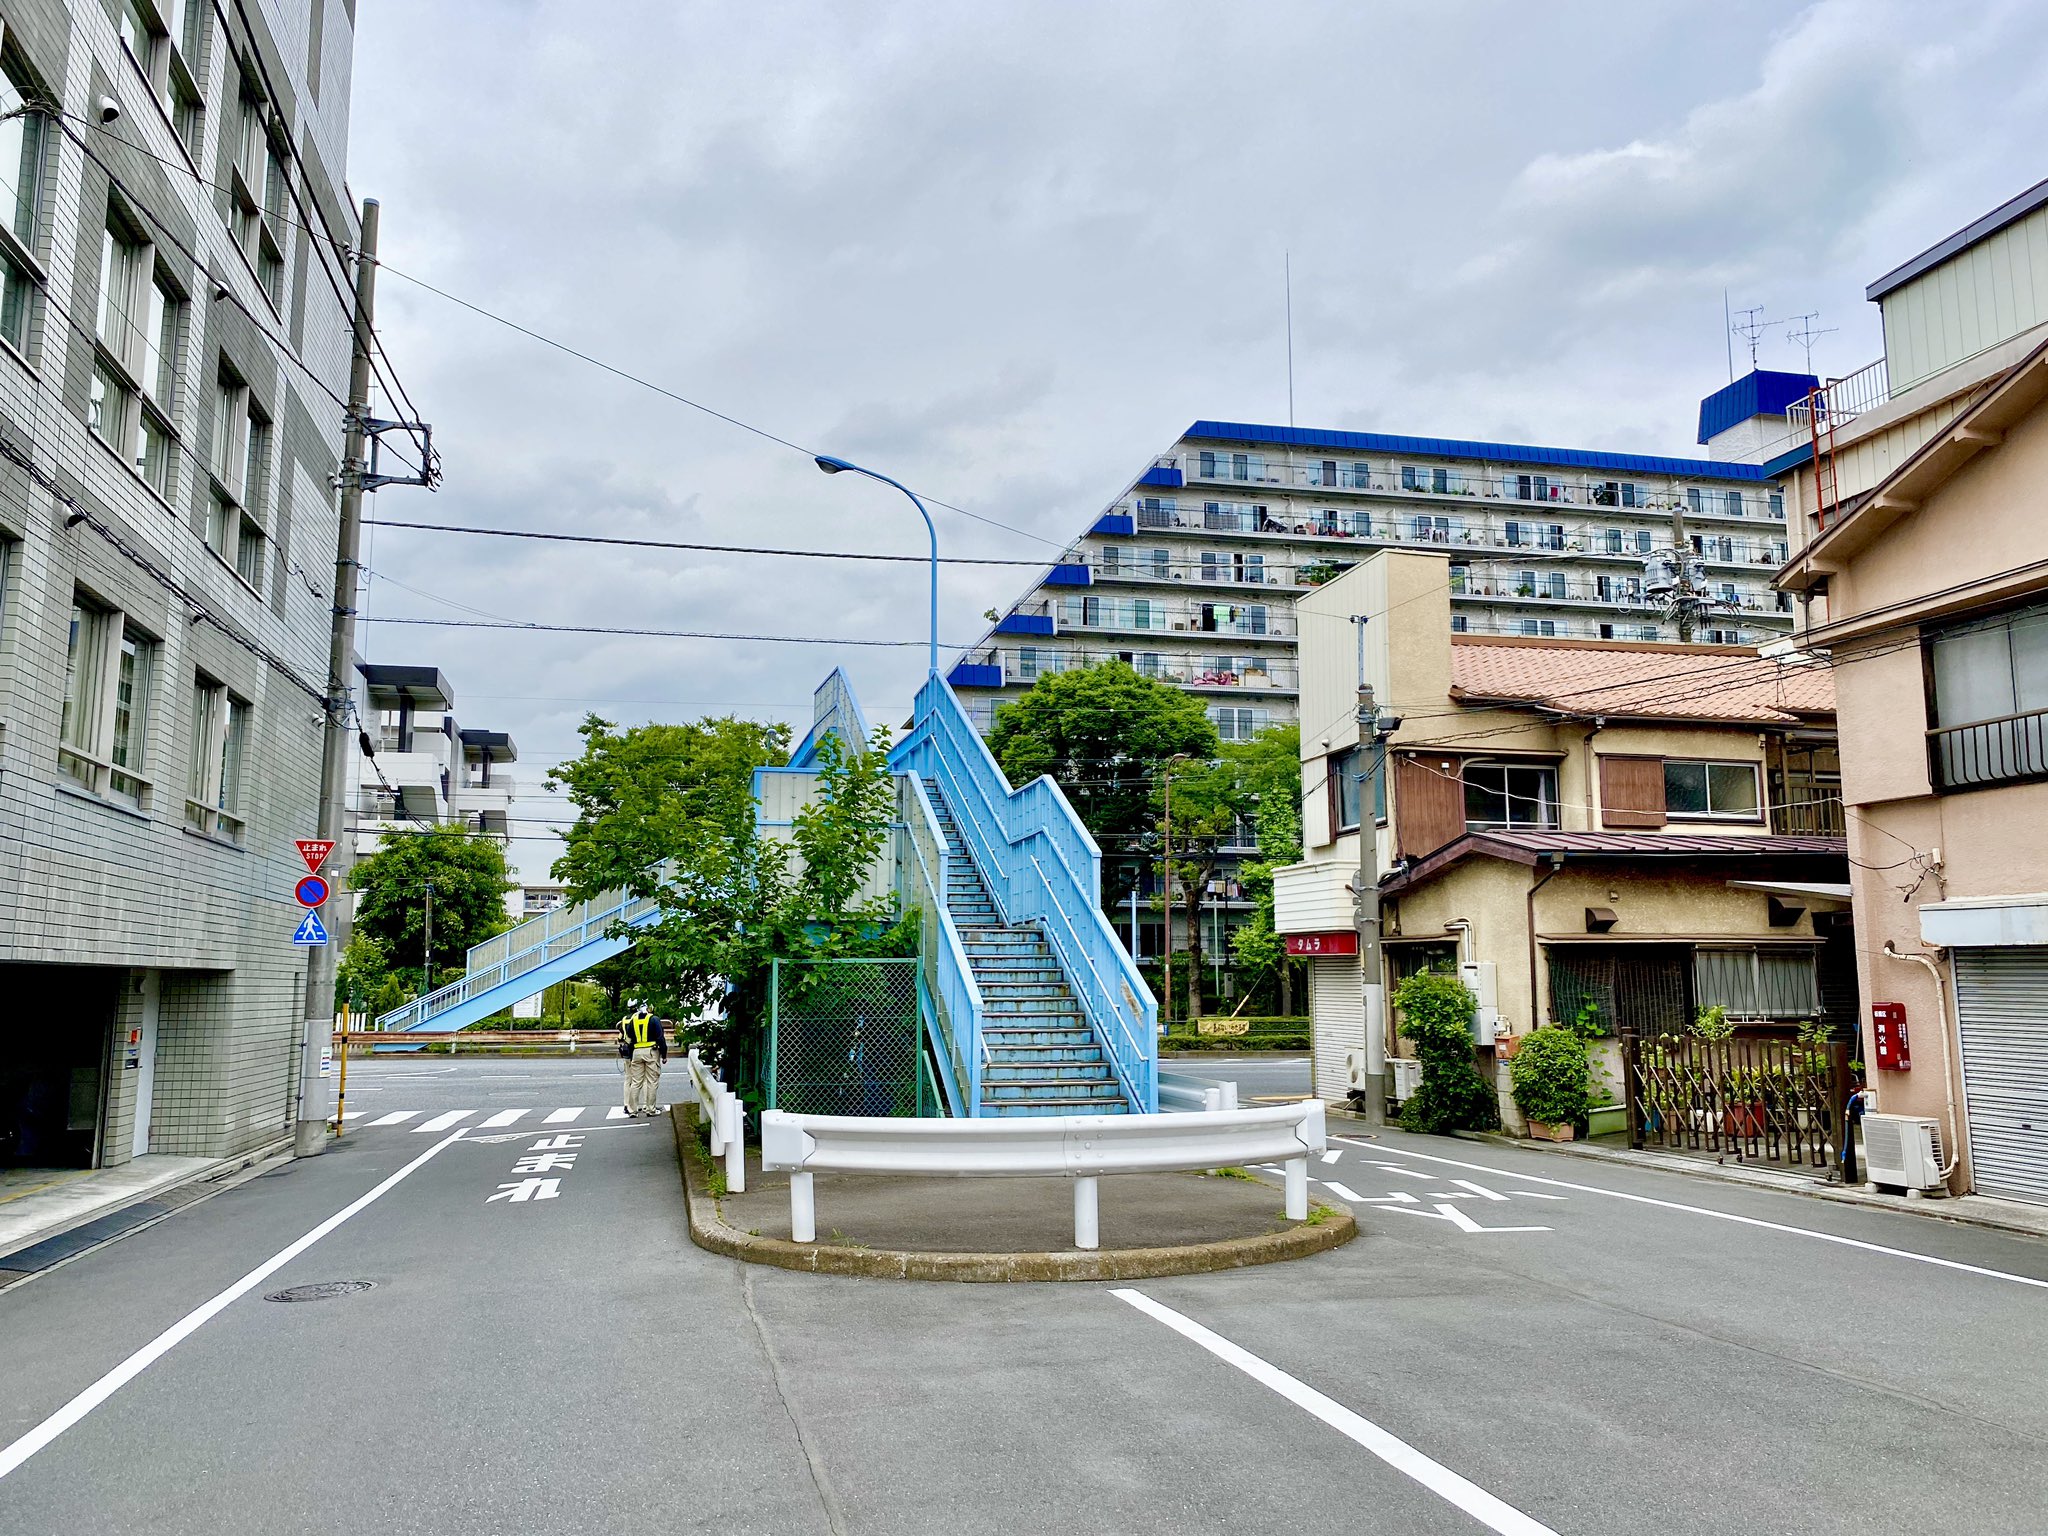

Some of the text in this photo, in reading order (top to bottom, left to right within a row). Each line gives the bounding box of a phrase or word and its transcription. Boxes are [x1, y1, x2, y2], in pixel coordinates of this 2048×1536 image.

[302, 843, 327, 851] 止まれ
[1298, 938, 1320, 950] タムラ
[485, 1134, 586, 1204] 止まれ
